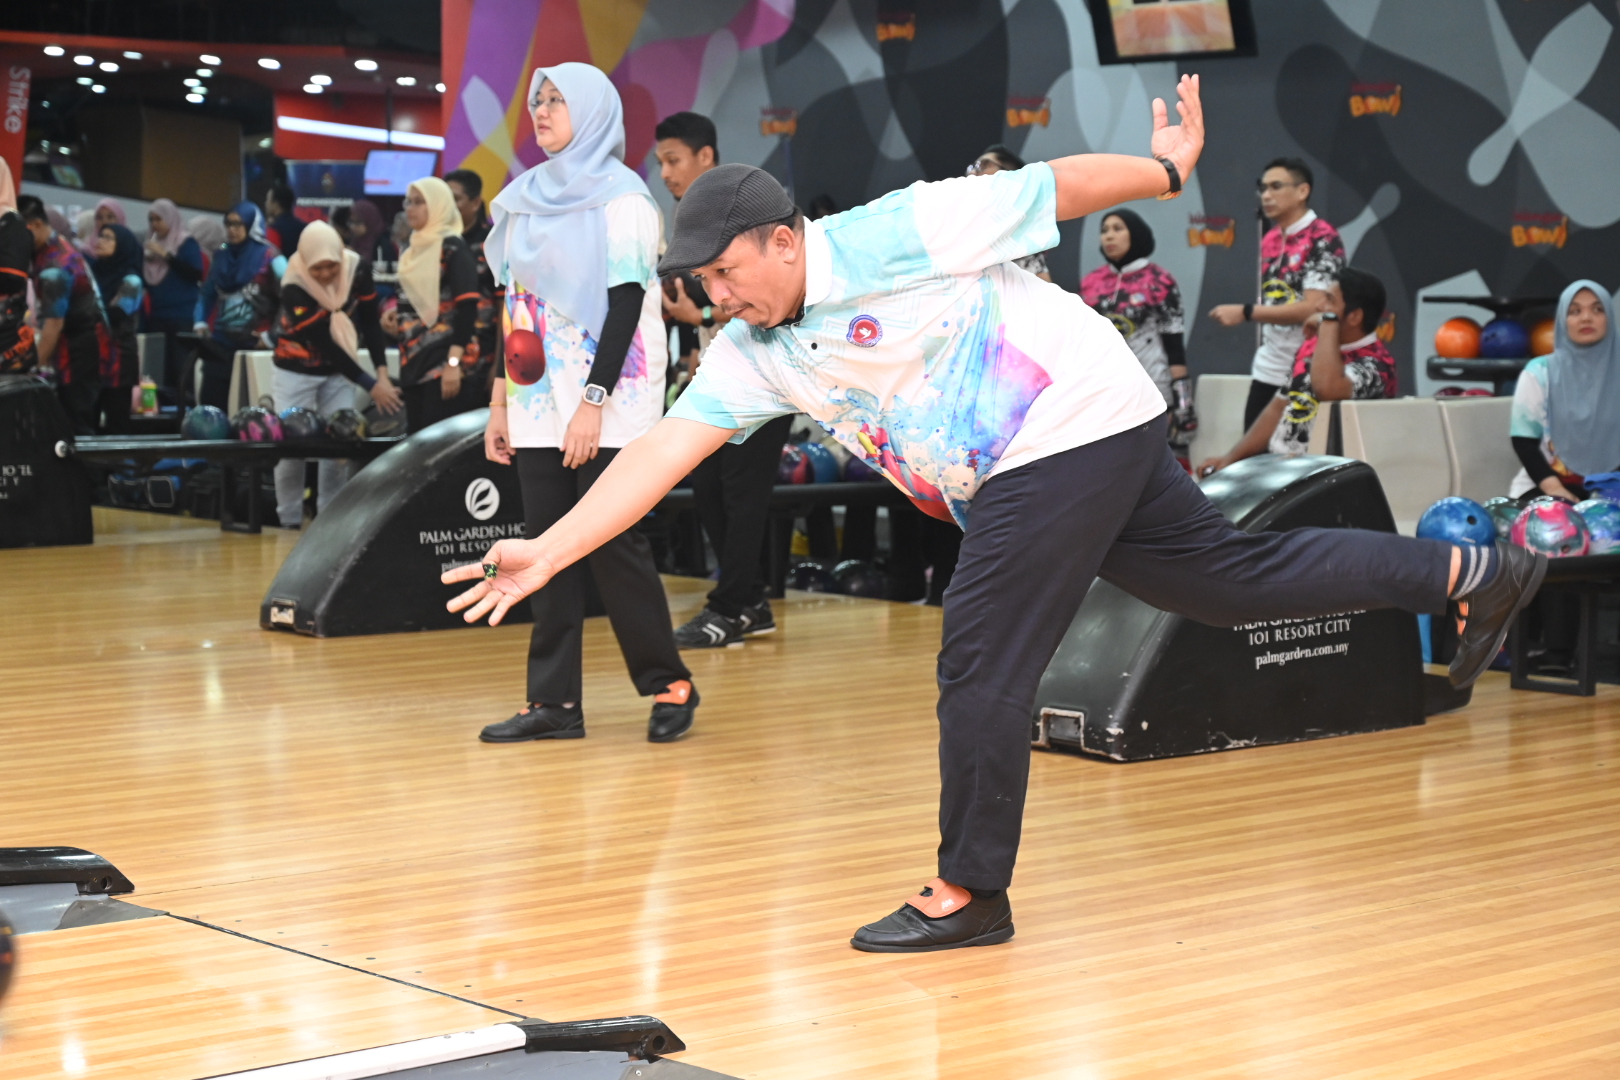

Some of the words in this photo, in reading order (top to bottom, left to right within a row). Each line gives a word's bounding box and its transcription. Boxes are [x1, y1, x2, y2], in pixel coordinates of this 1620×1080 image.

[4, 65, 31, 134] Strike
[419, 530, 452, 544] PALM
[454, 524, 506, 542] GARDEN
[459, 540, 497, 554] RESO
[1275, 623, 1322, 642] RESORT
[1325, 618, 1351, 634] CITY
